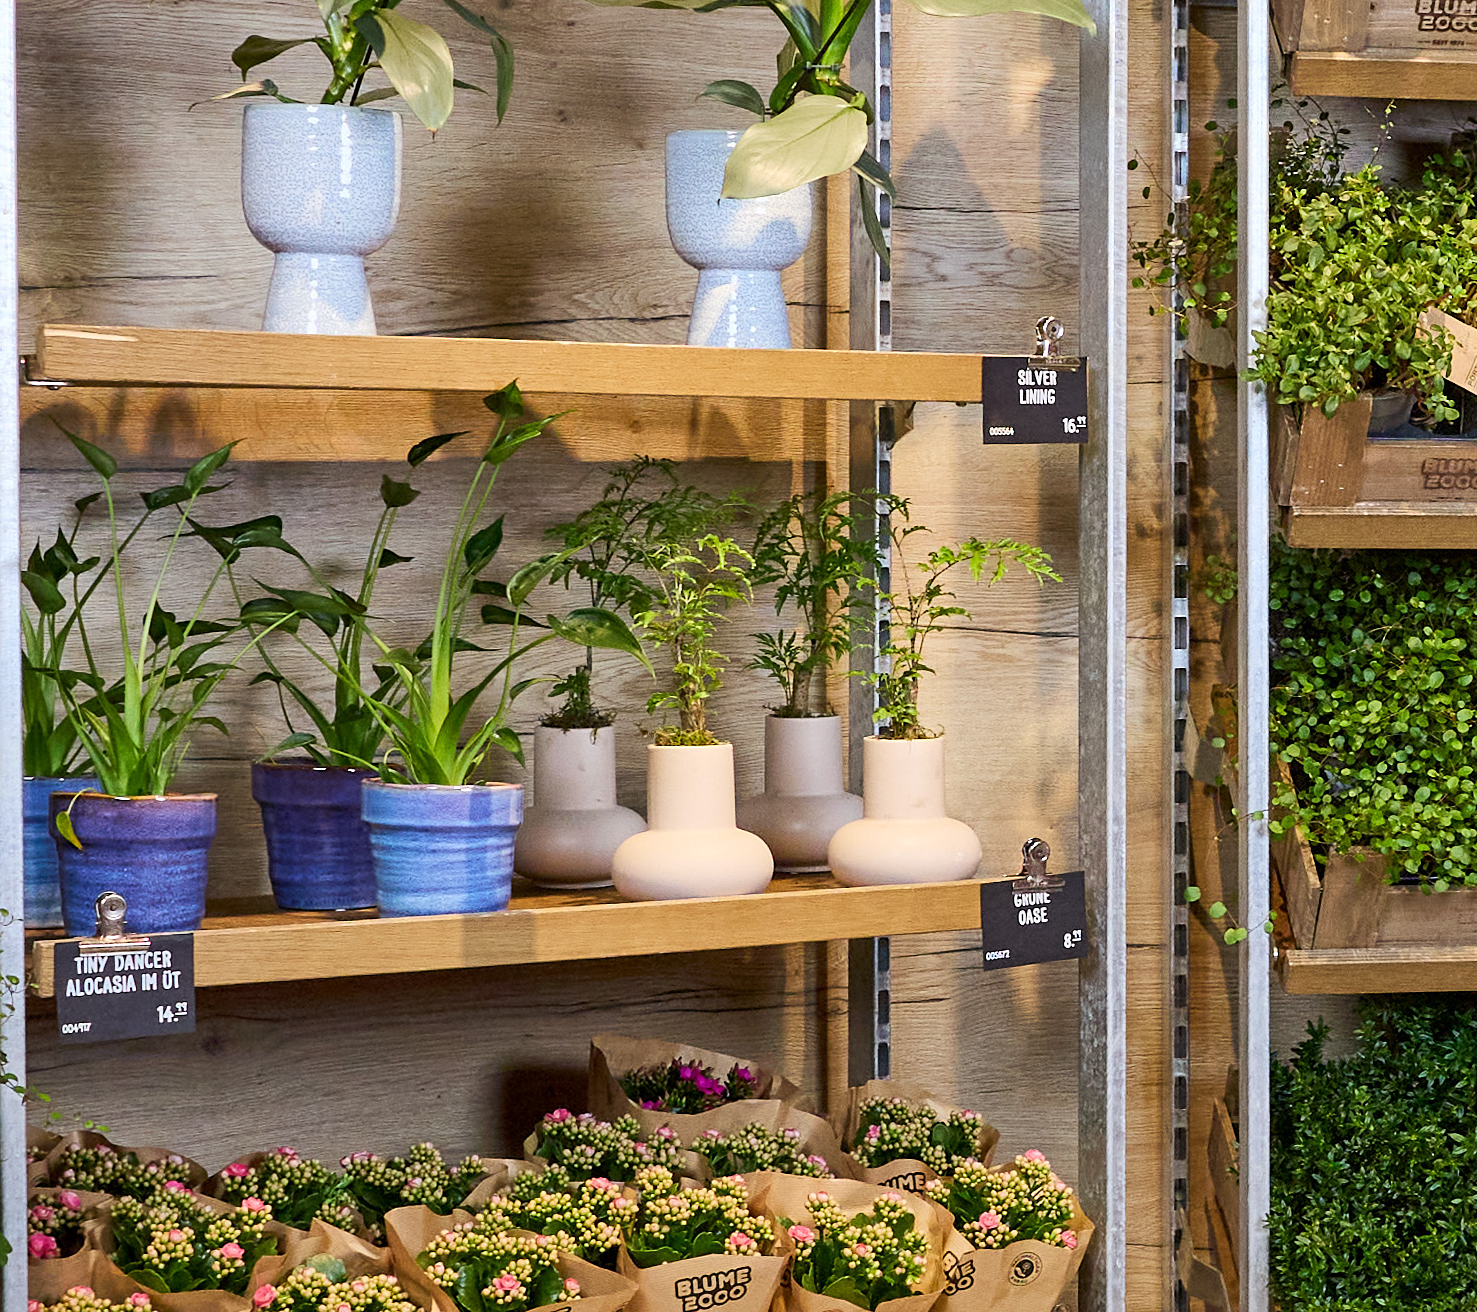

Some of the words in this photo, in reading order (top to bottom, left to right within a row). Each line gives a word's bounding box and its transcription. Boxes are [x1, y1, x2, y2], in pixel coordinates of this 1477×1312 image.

[1017, 369, 1058, 386] SILVER
[1019, 389, 1056, 405] LINING
[1018, 907, 1049, 926] OASE
[74, 955, 108, 975] TINY
[114, 950, 172, 970] DANCER
[65, 973, 136, 997] ALOCASIA
[141, 974, 157, 991] IM
[162, 970, 181, 990] ÜT
[676, 1266, 752, 1298] BLUME
